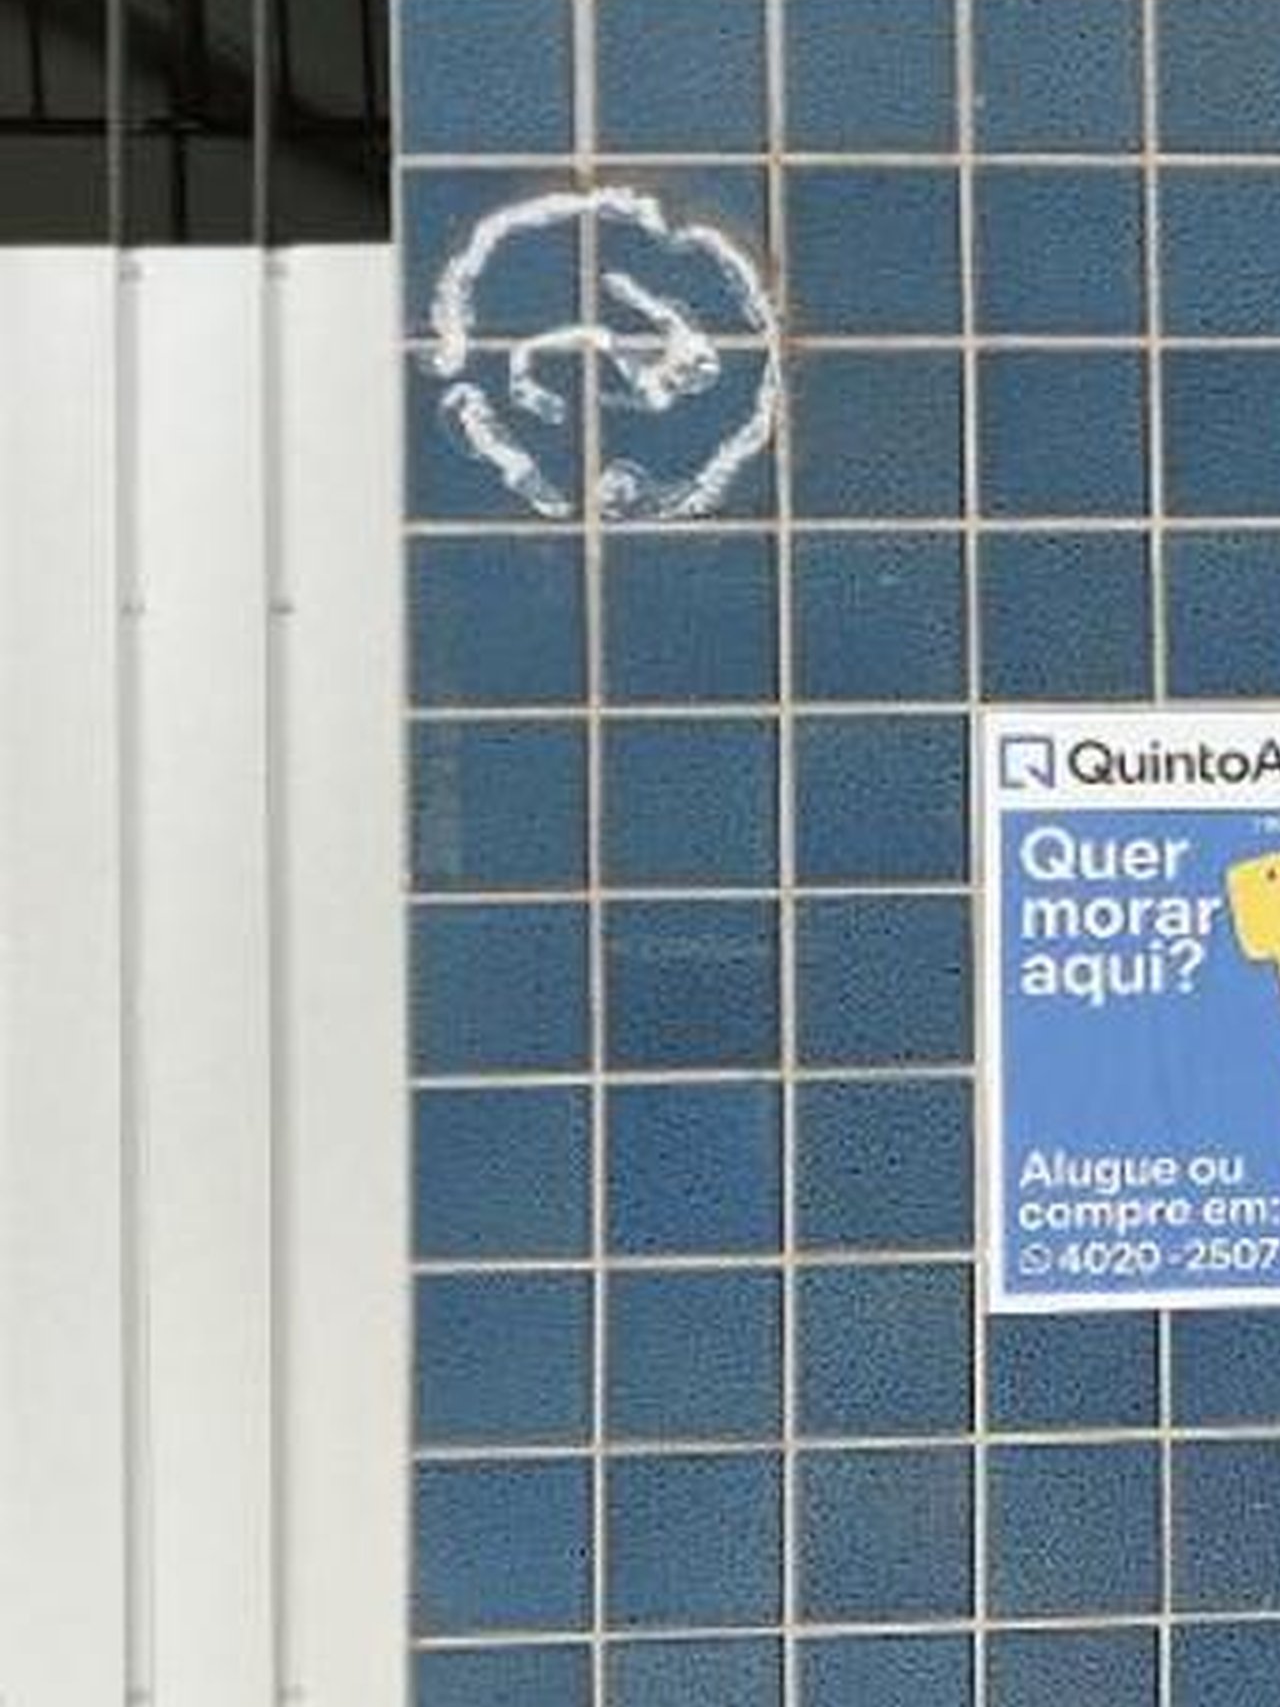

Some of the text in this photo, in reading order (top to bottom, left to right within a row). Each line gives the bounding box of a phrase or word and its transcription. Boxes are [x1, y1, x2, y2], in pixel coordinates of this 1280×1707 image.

[1019, 826, 1191, 882] Quer
[1020, 896, 1224, 938] morar
[1019, 938, 1205, 1006] aqui?
[1018, 1148, 1245, 1196] Alugue ou
[1018, 1198, 1193, 1237] compre
